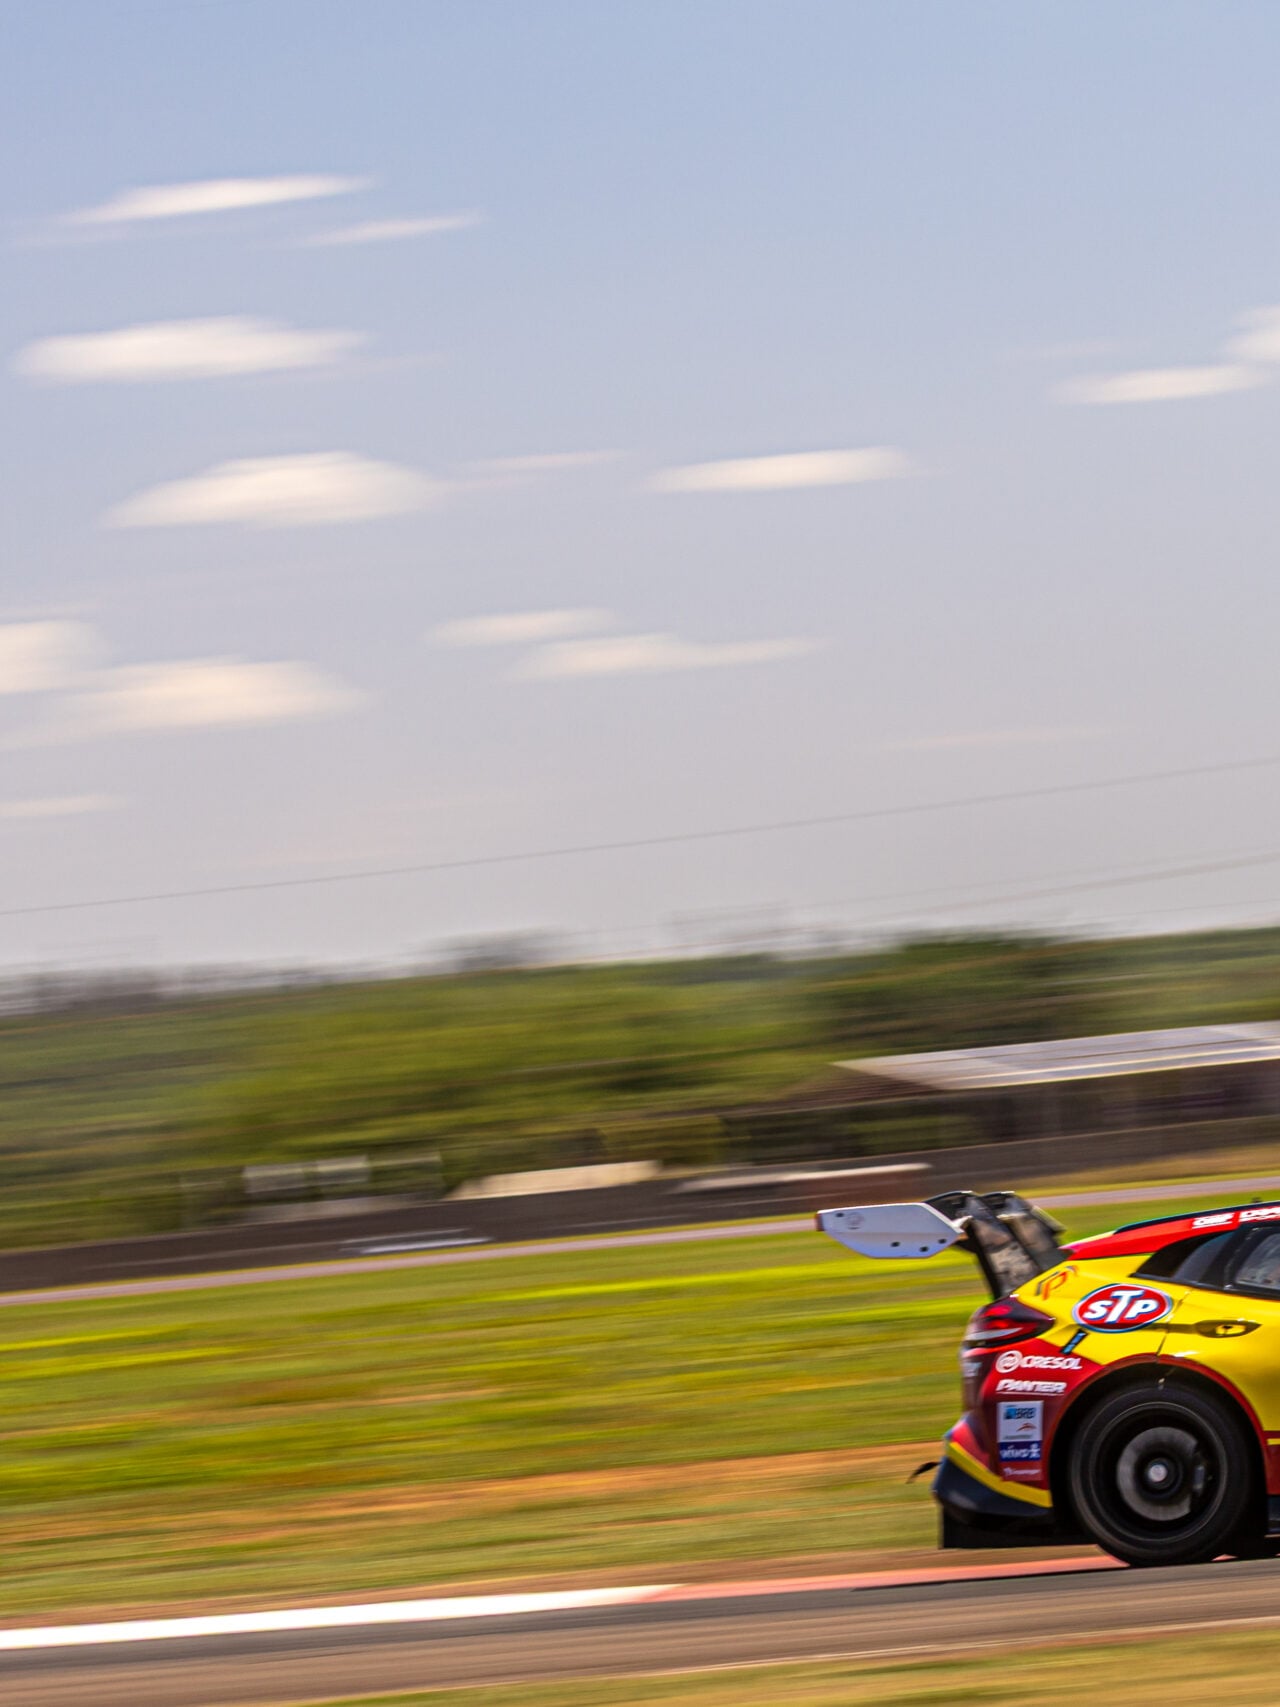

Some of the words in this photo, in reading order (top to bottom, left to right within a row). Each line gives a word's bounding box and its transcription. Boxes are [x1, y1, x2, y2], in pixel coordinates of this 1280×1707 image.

[1084, 1290, 1158, 1323] STP
[1021, 1355, 1082, 1369] CRESOL
[996, 1379, 1067, 1393] PANTER
